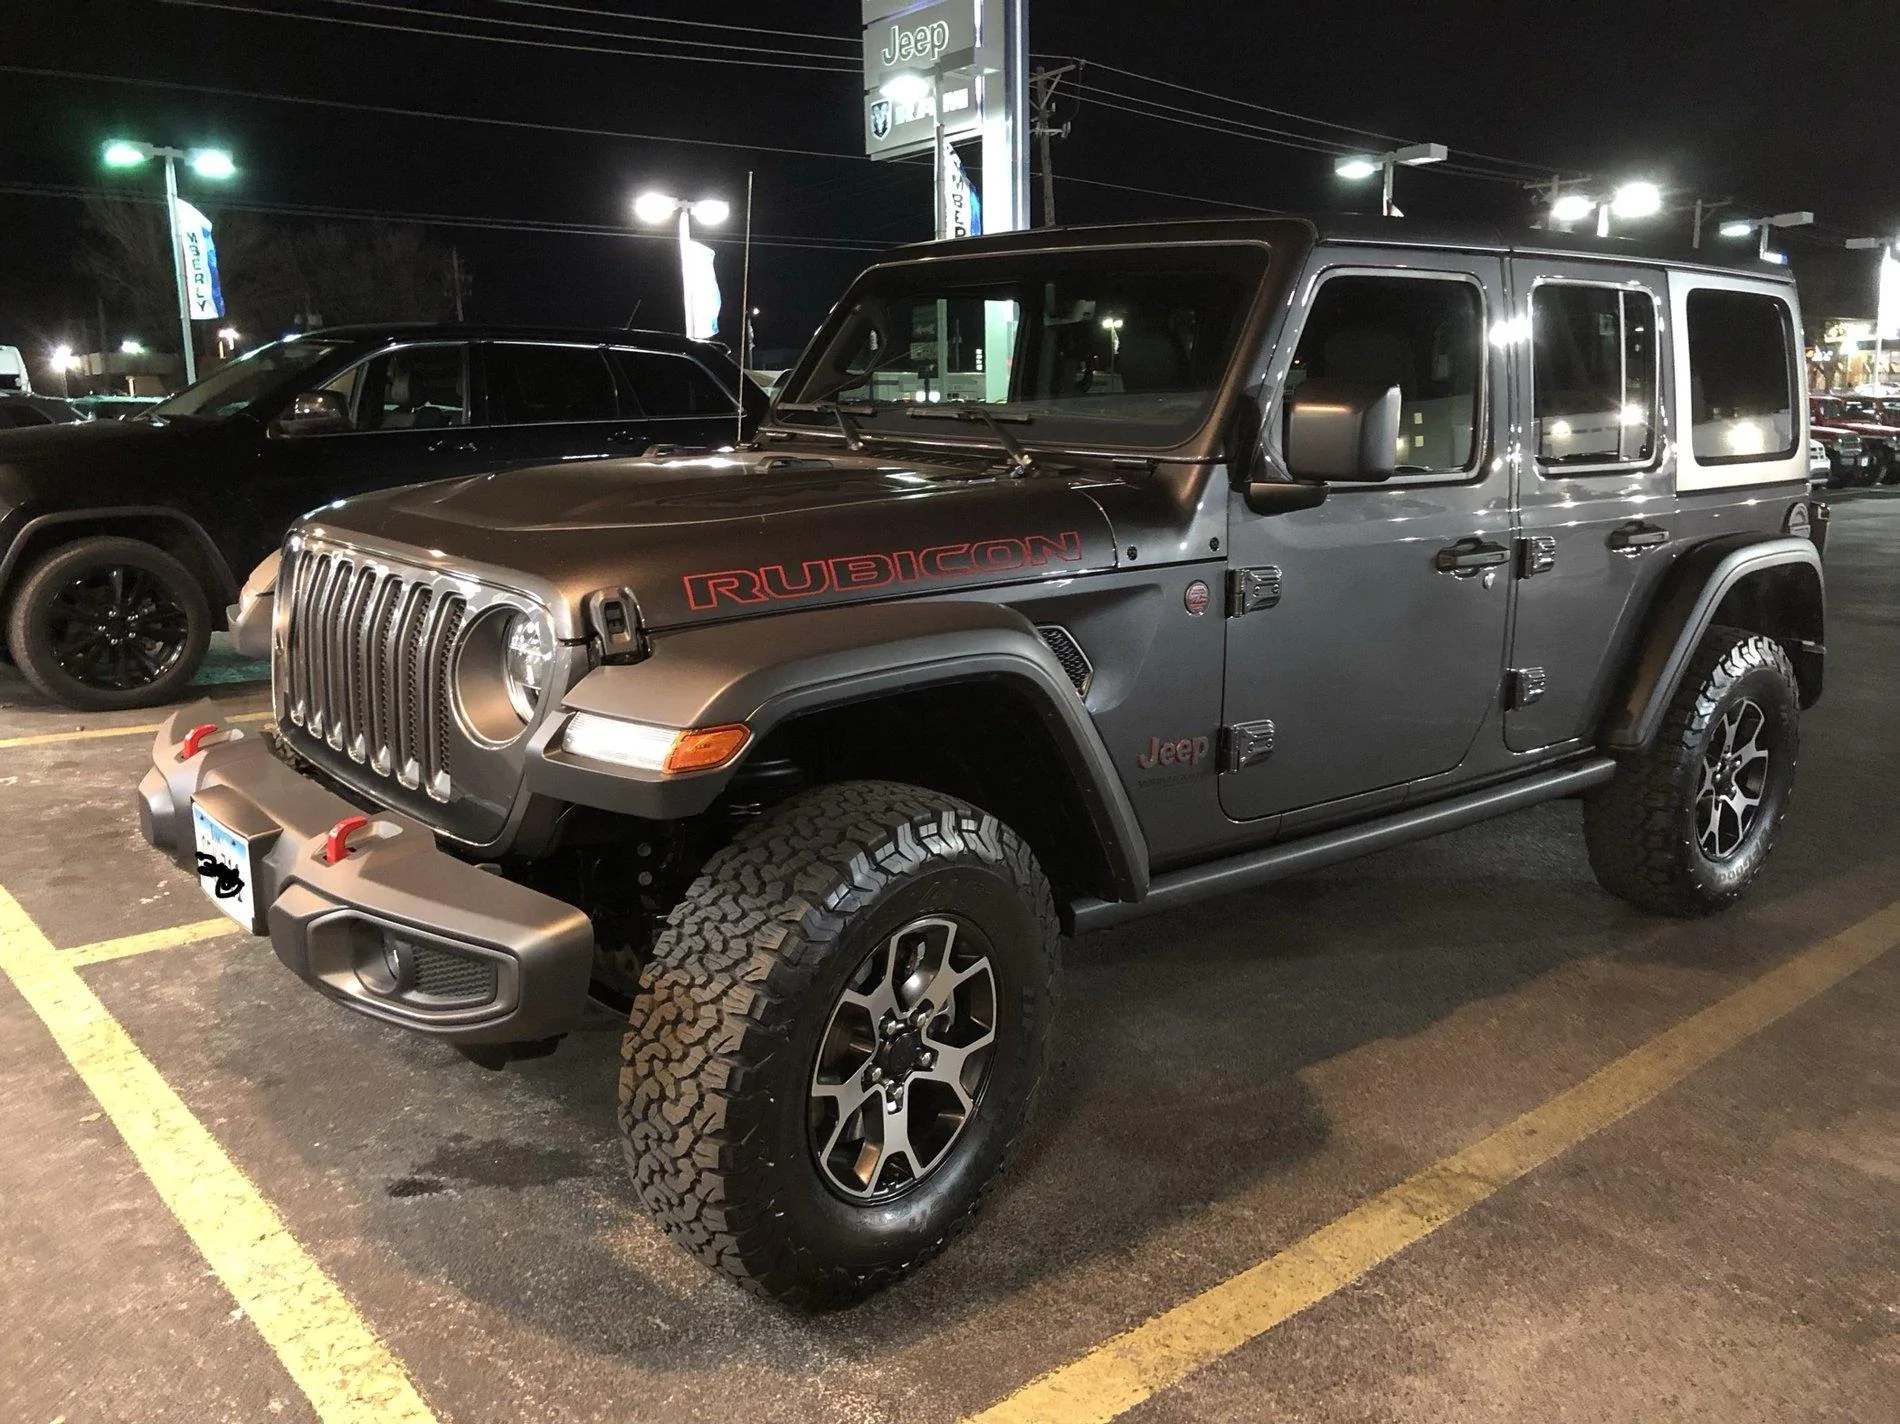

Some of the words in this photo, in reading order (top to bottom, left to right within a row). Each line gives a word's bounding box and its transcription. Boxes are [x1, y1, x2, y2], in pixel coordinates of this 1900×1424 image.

[881, 20, 949, 66] Jeep
[682, 531, 1082, 610] RUBICON
[1138, 736, 1209, 769] Jeep
